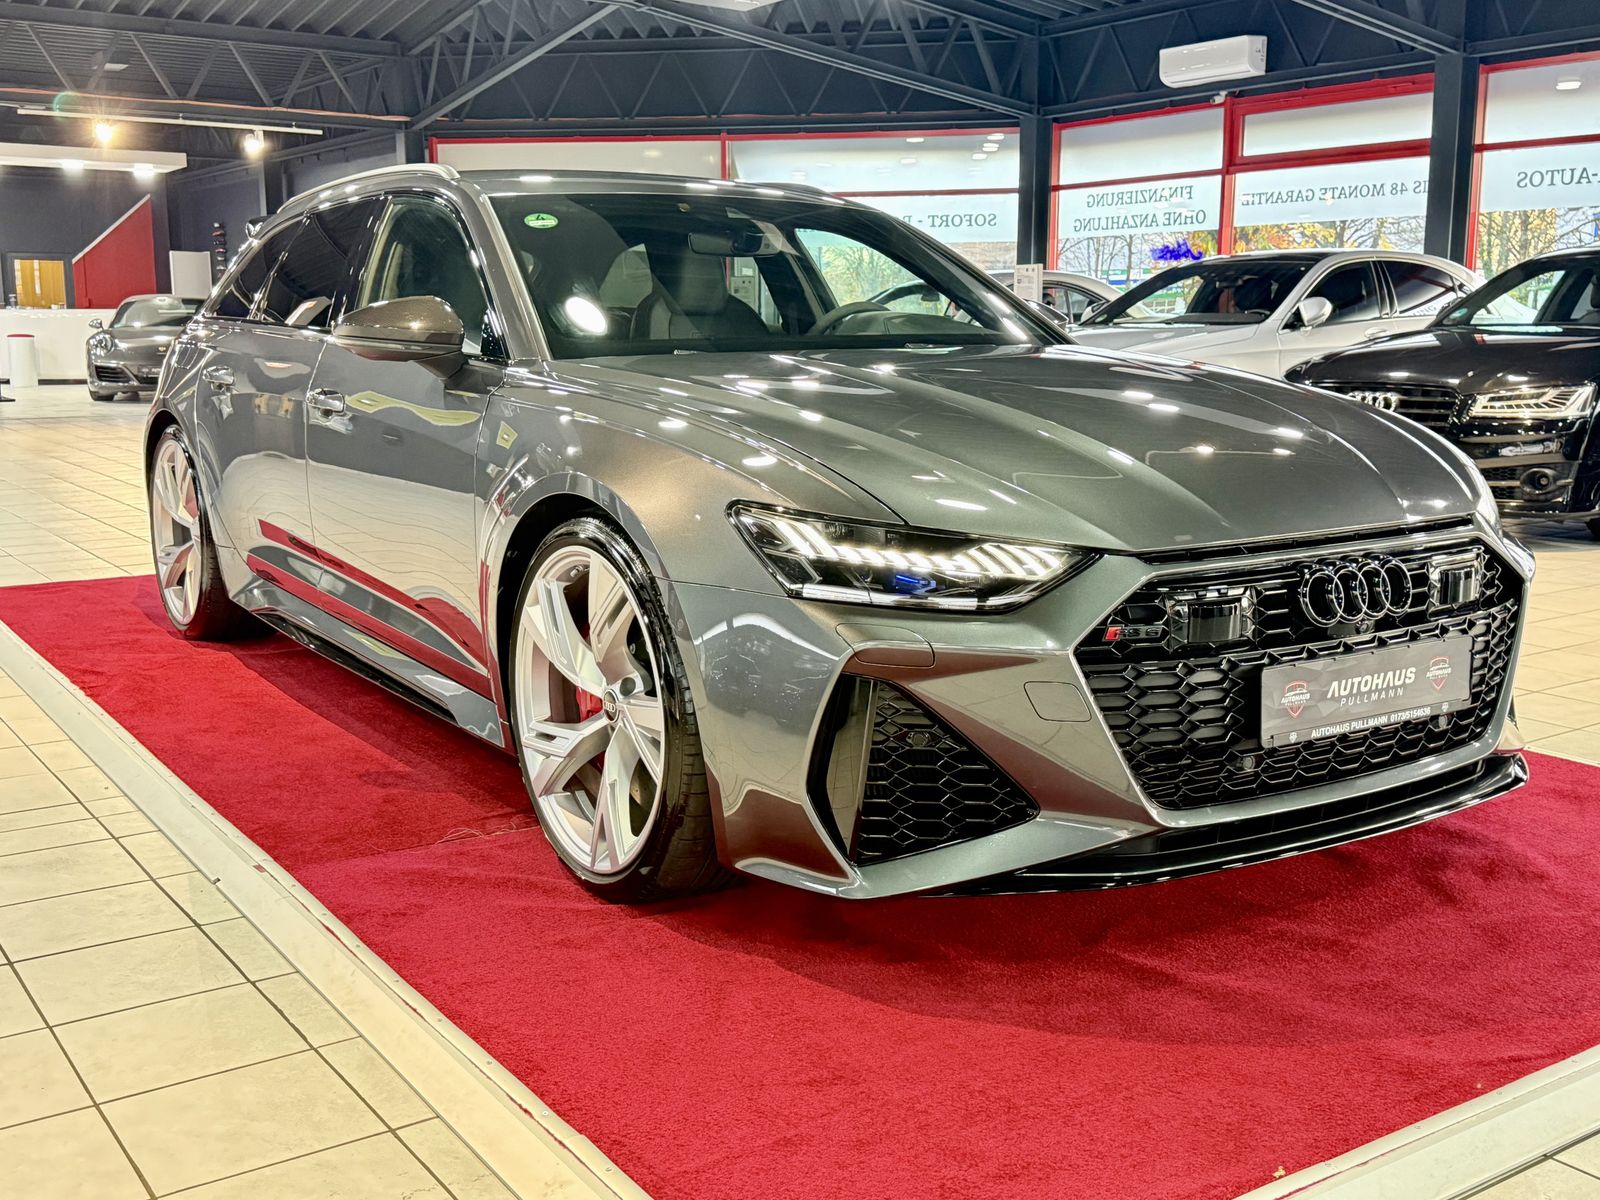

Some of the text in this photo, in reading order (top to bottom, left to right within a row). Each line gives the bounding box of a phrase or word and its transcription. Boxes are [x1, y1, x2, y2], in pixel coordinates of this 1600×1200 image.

[1326, 667, 1417, 699] AUTOHAUS
[1340, 687, 1404, 707] PULLMANN
[1311, 722, 1350, 738] AUTOHAUS
[1350, 716, 1388, 730] PULLMANN
